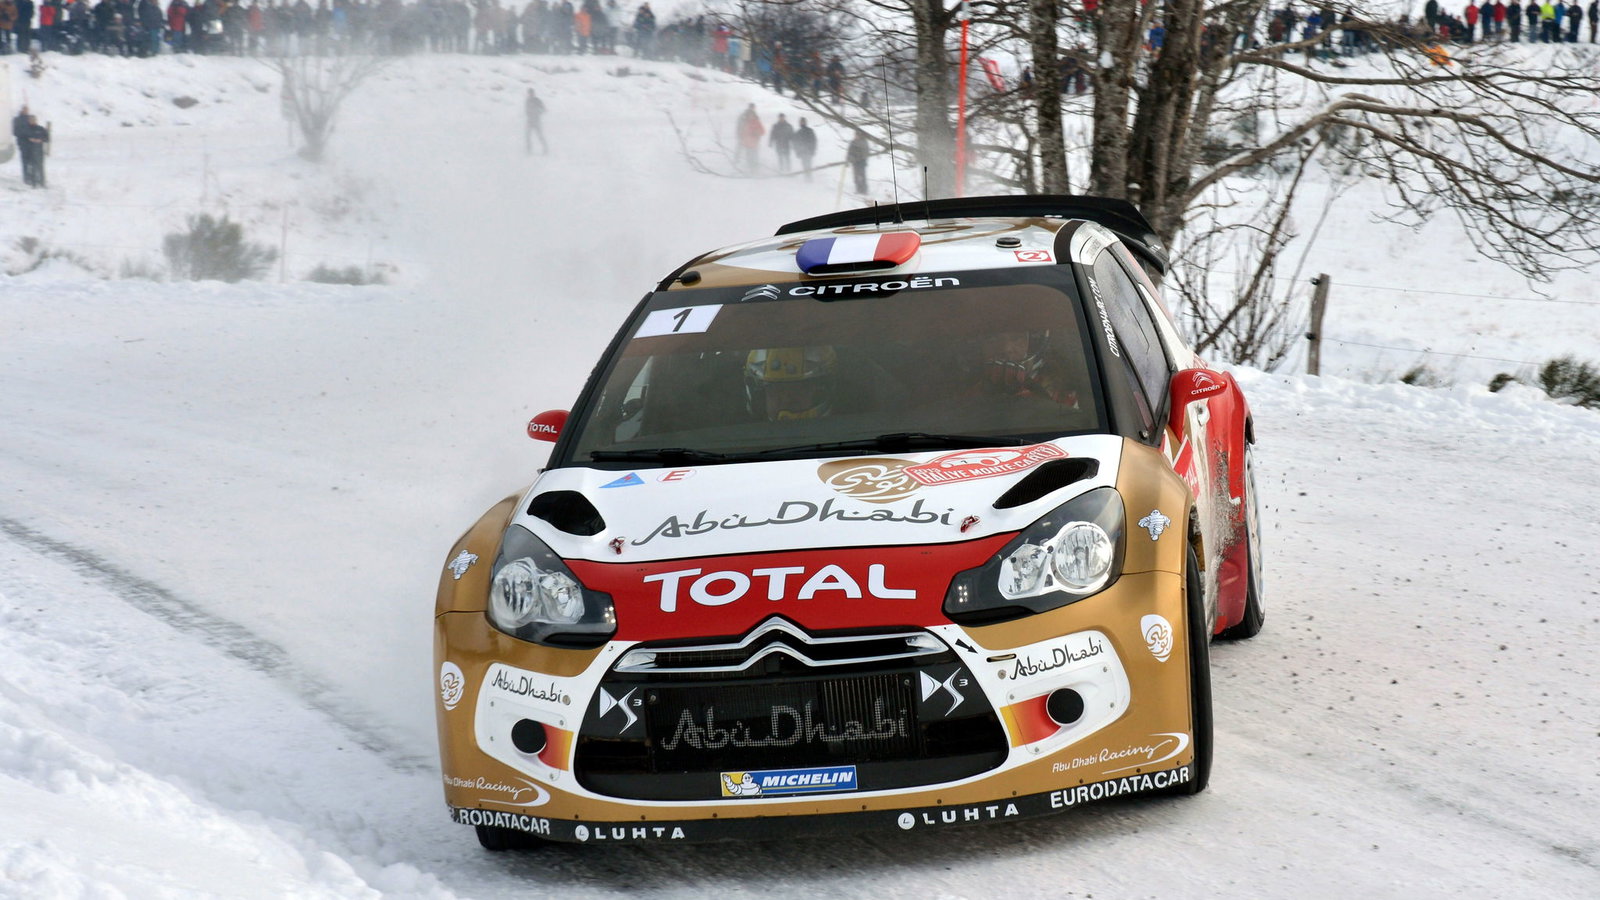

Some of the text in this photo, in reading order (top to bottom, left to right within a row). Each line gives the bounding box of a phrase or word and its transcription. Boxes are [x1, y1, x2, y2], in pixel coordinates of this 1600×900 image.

[789, 275, 960, 297] CITROËN
[673, 308, 693, 333] 1
[529, 422, 557, 433] TOTAL
[662, 470, 690, 481] E
[916, 470, 969, 483] RALLYE
[770, 498, 955, 526] Dhabi
[643, 563, 917, 613] TOTAL
[1051, 637, 1104, 669] Dhabi
[517, 676, 562, 704] Dhabi
[770, 696, 908, 745] Dhabi
[1052, 739, 1173, 774] Abu Dhabi Racing
[454, 777, 475, 788] Dhabi
[476, 776, 532, 801] Racing
[761, 771, 853, 787] MICHELIN
[1050, 766, 1190, 809] EURODATACAR
[923, 803, 1019, 825] LUHTA
[595, 826, 685, 841] LUHTA
